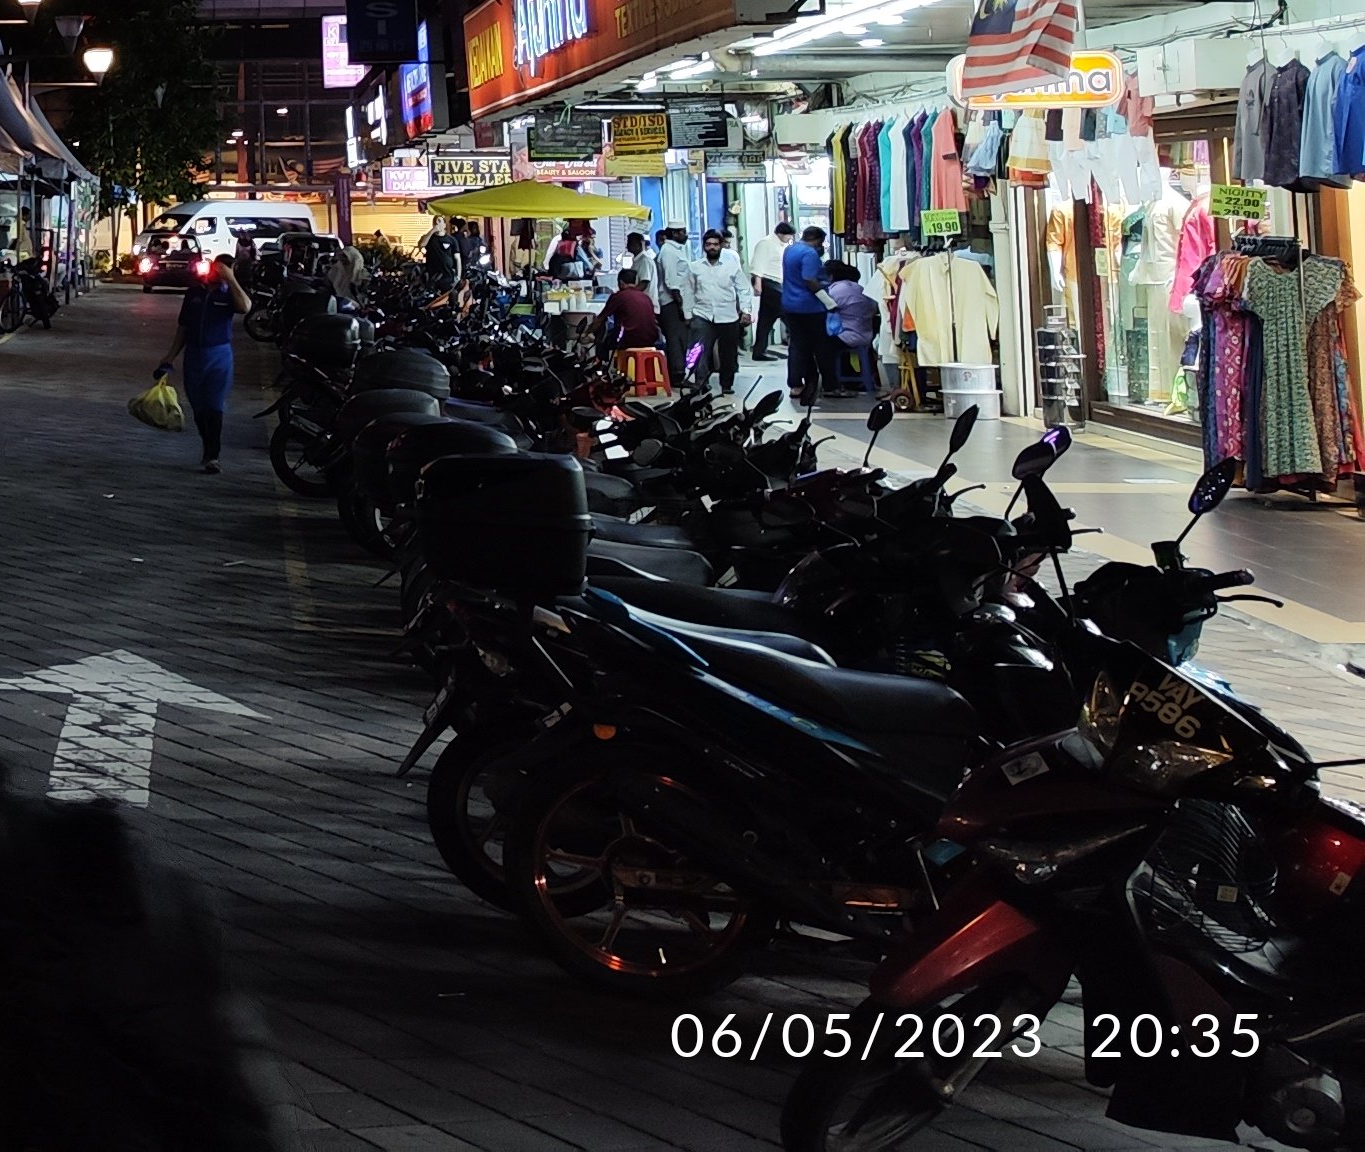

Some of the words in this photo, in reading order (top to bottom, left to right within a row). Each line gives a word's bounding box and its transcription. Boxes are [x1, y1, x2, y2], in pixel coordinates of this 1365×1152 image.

[612, 114, 665, 129] STD/ISD
[433, 160, 474, 174] FIVE
[478, 160, 510, 174] STA
[434, 173, 513, 186] JEWELLER
[1219, 188, 1267, 199] NIGHTY
[931, 221, 959, 234] 19.90
[1157, 672, 1205, 710] VAY
